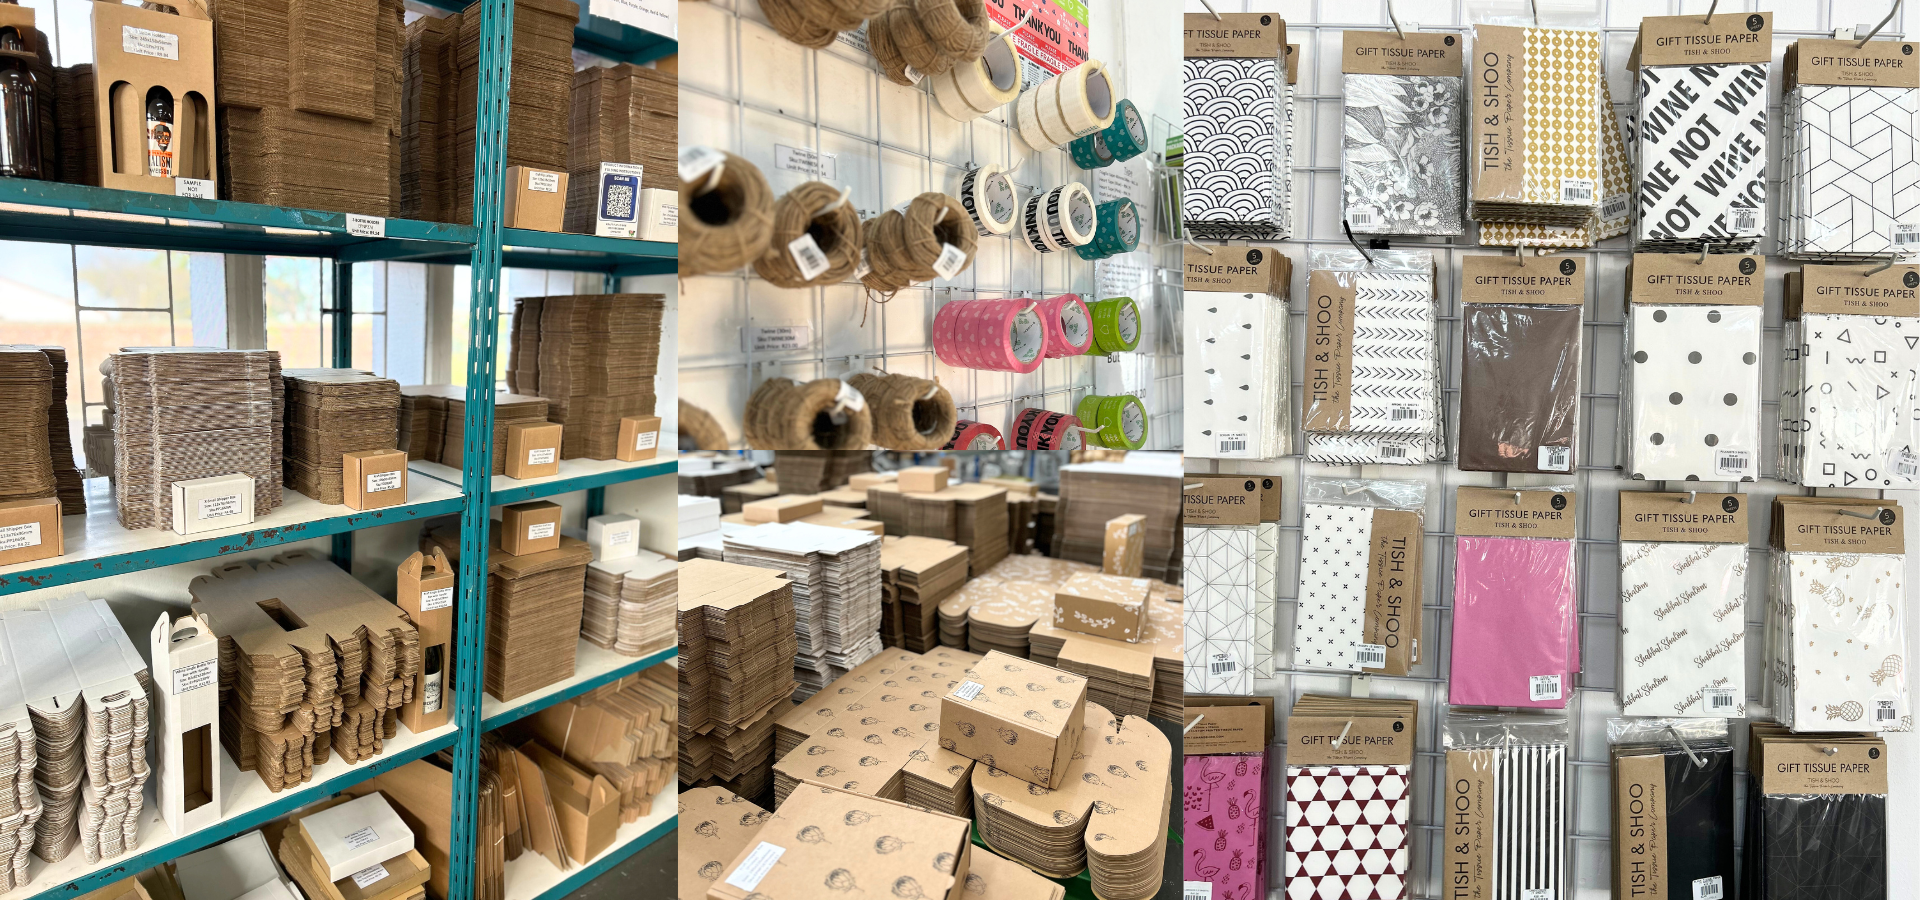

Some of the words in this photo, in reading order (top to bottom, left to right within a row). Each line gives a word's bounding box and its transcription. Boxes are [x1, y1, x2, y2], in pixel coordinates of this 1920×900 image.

[1013, 3, 1043, 35] THANK
[1044, 23, 1061, 45] YOU
[1197, 30, 1229, 39] TISSUE
[1232, 30, 1261, 39] PAPER
[1656, 36, 1682, 46] GIFT
[1685, 35, 1721, 45] TISSUE
[1725, 33, 1759, 43] PAPER
[1068, 39, 1089, 62] THAN
[1355, 47, 1378, 56] GIFT
[1381, 47, 1414, 57] TISSUE
[1417, 49, 1446, 58] PAPER
[1811, 56, 1834, 66] GIFT
[1837, 57, 1871, 67] TISSUE
[1874, 58, 1904, 68] PAPER
[1483, 52, 1499, 108] SHOO
[1483, 114, 1499, 126] &
[1668, 112, 1721, 169] NOT
[1483, 133, 1499, 171] TISH
[1693, 131, 1761, 198] WINE
[1188, 264, 1223, 274] TISSUE
[1226, 265, 1258, 275] PAPER
[1475, 276, 1499, 285] GIFT
[1502, 276, 1536, 286] TISSUE
[1540, 277, 1572, 286] PAPER
[1647, 274, 1673, 284] GIFT
[1676, 275, 1714, 285] TISSUE
[1717, 276, 1751, 286] PAPER
[1816, 286, 1841, 295] GIFT
[1844, 286, 1880, 297] TISSUE
[1883, 288, 1916, 299] PAPER
[1843, 299, 1860, 307] TISH
[1315, 295, 1332, 346] SHOO
[1315, 352, 1329, 363] &
[1313, 369, 1329, 402] TISH
[1184, 494, 1214, 505] TISSUE
[1217, 495, 1246, 505] PAPER
[1469, 509, 1493, 518] GIFT
[1495, 510, 1529, 519] TISSUE
[1532, 511, 1562, 520] PAPER
[1634, 513, 1659, 523] GIFT
[1662, 514, 1699, 523] TISSUE
[1702, 514, 1735, 524] PAPER
[1797, 524, 1820, 534] GIFT
[1823, 525, 1857, 535] TISSUE
[1860, 526, 1892, 536] PAPER
[1390, 536, 1406, 572] TISH
[1389, 577, 1403, 589] &
[1654, 597, 1682, 621] Shabbat
[1679, 582, 1708, 604] Shalom
[1713, 598, 1742, 623] Shabbat
[1385, 596, 1402, 648] SHOO
[1634, 643, 1663, 668] Shabbat
[1660, 628, 1688, 650] Shalom
[1694, 644, 1722, 669] Shabbat
[1641, 675, 1668, 697] Shalom
[1301, 735, 1324, 745] GIFT
[1364, 736, 1394, 745] PAPER
[1777, 763, 1800, 773] GIFT
[1803, 763, 1837, 773] TISSUE
[1840, 763, 1870, 773] PAPER
[1455, 778, 1470, 836] SHOO
[1629, 783, 1645, 837] SHOO
[1455, 842, 1469, 855] &
[1630, 842, 1645, 855] &
[1454, 861, 1469, 900] TISH
[1631, 861, 1646, 898] TISH
